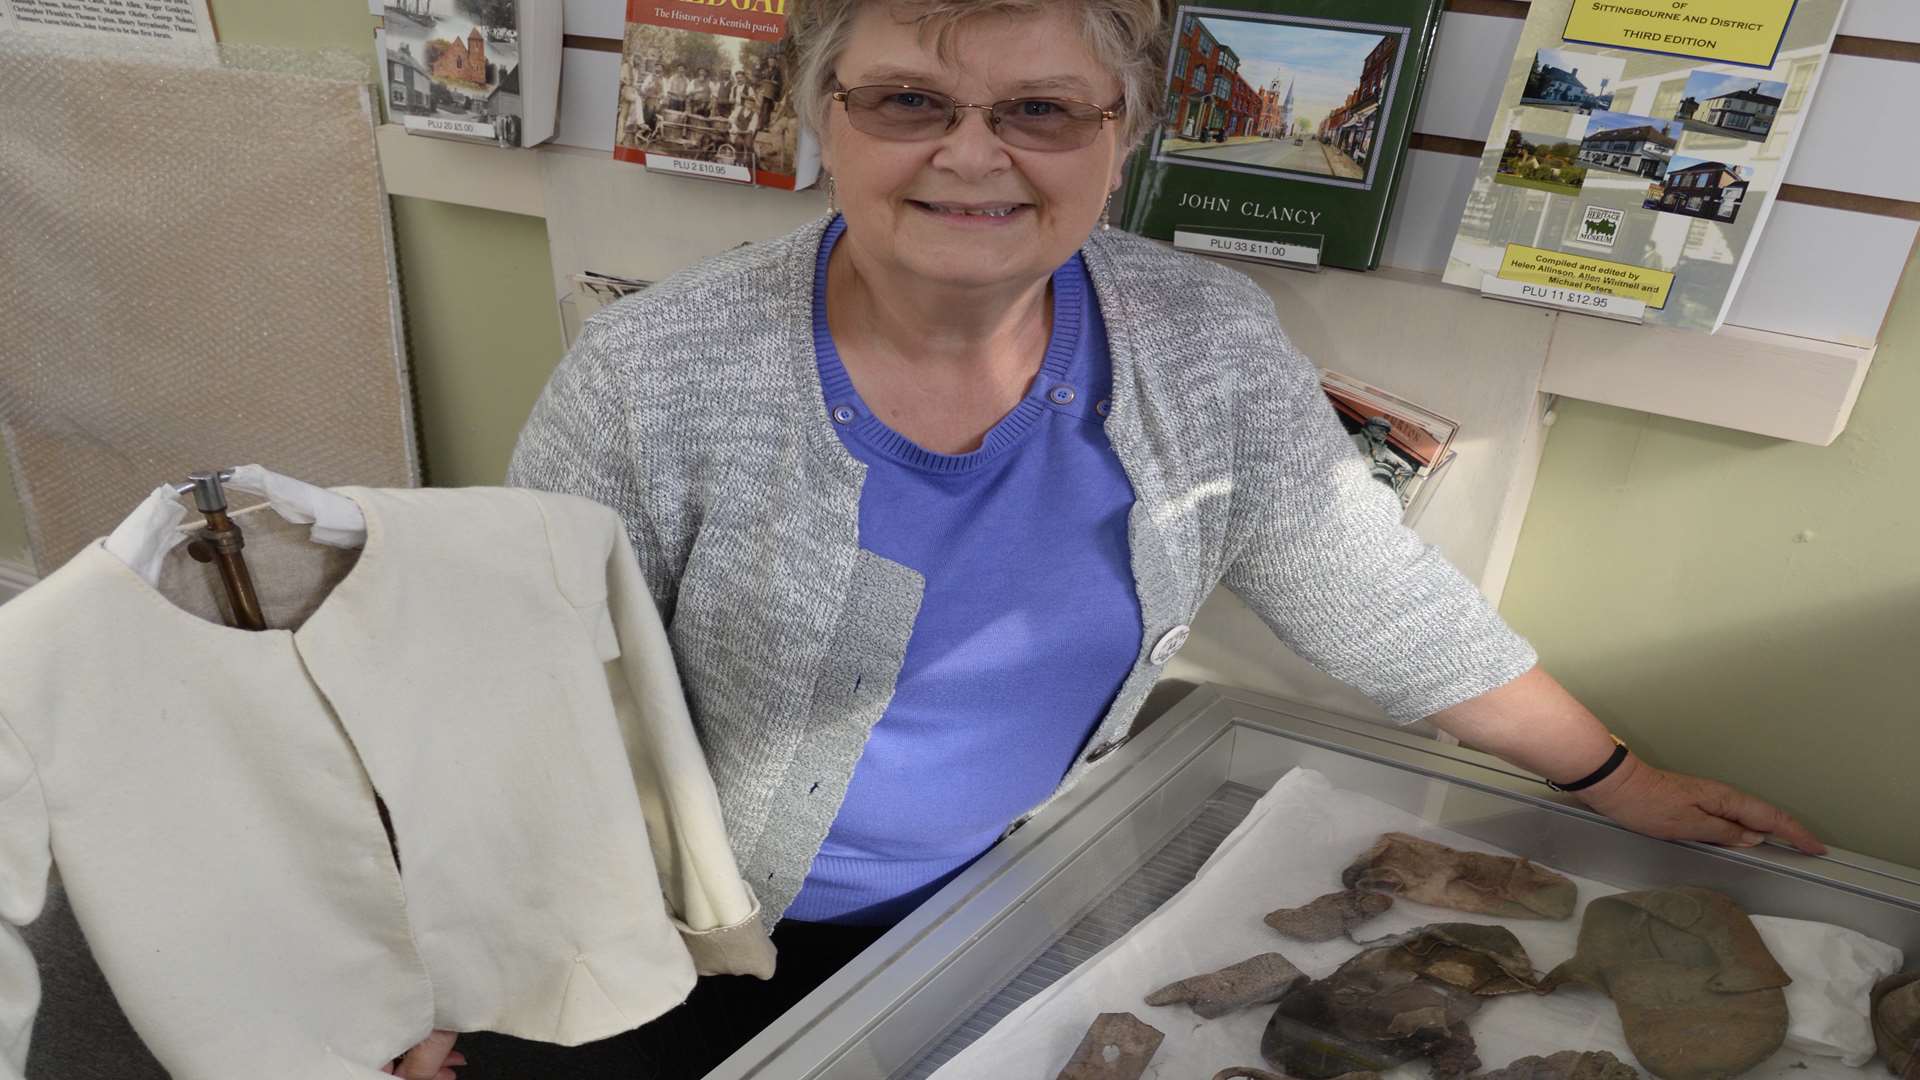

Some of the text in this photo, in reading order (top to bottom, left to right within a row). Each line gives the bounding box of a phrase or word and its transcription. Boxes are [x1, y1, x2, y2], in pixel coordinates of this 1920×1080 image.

[1591, 2, 1764, 32] SITTINGBOURNE AND DISTRICT
[1672, 1, 1689, 9] OF
[654, 7, 670, 19] The
[671, 9, 701, 25] History
[702, 15, 713, 25] of
[719, 17, 751, 30] Kentish
[752, 22, 779, 34] parish
[1623, 28, 1717, 49] THIRD EDITION
[673, 160, 726, 175] PLU 2 £10.95
[1178, 193, 1321, 225] JOHN CLANCY
[1210, 238, 1286, 257] PLU 33 £11.00
[1511, 260, 1536, 271] Helen
[1641, 285, 1660, 294] and
[1535, 255, 1641, 281] Compiled and edited by
[1522, 285, 1608, 309] PLU 11 £12.95
[1548, 276, 1613, 294] Michael Peters
